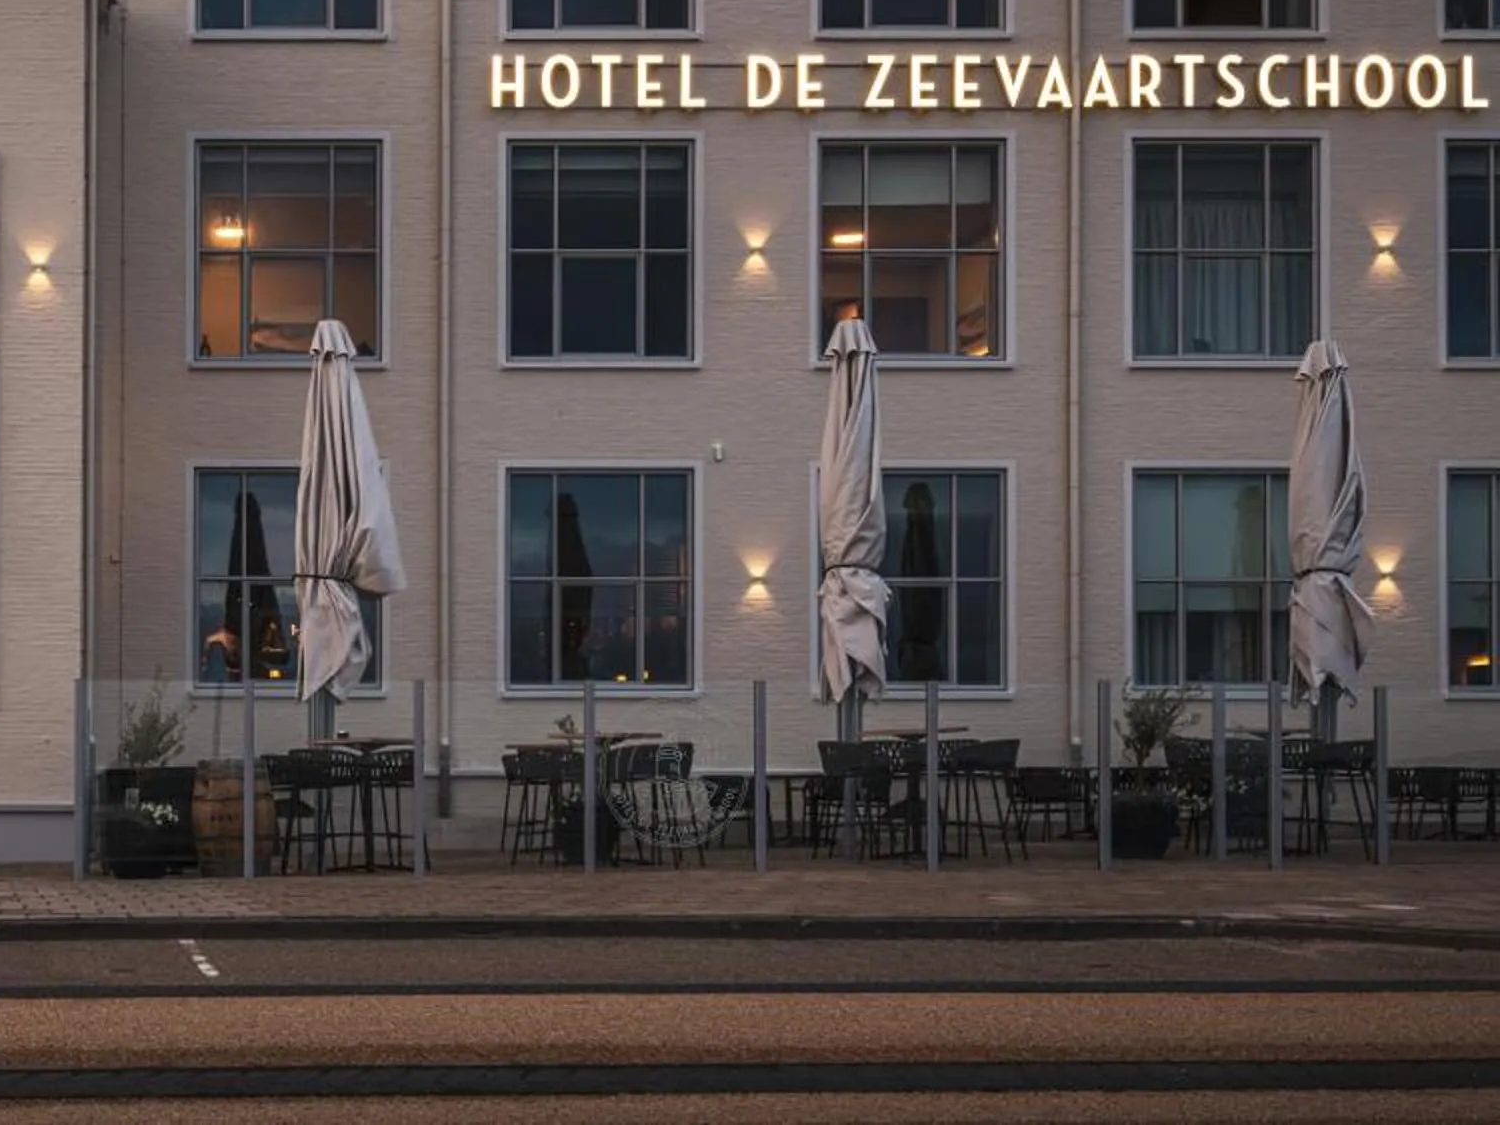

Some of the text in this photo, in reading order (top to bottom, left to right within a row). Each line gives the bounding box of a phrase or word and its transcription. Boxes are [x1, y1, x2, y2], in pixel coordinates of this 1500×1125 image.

[490, 53, 1489, 108] HOTEL DE ZEEVAARTSCHOOL
